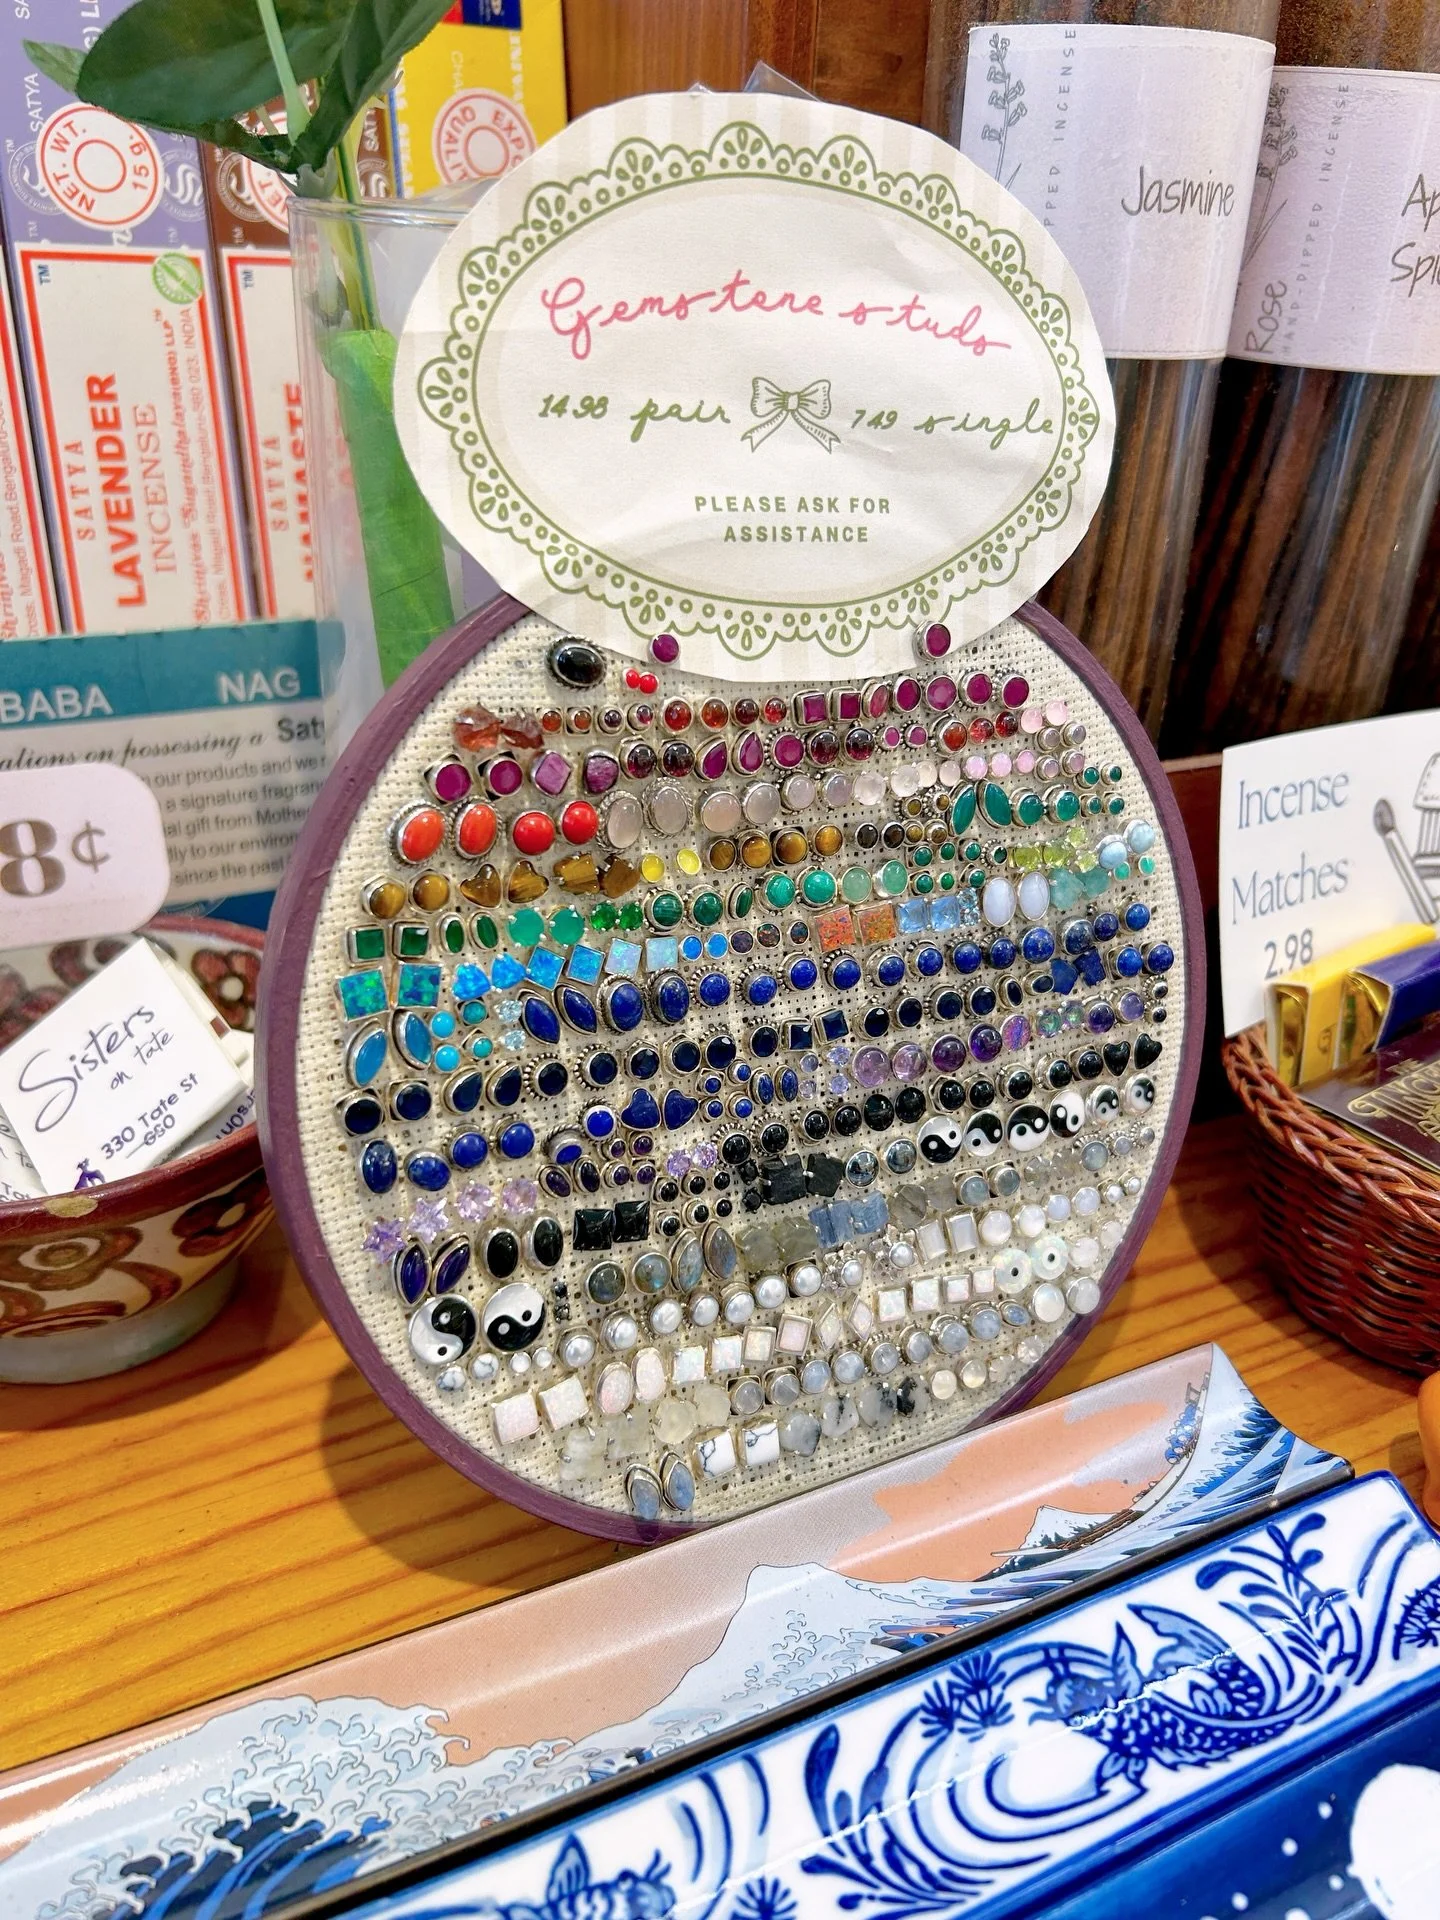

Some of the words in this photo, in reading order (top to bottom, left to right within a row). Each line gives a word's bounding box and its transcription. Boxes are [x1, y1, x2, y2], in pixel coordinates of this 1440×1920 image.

[24, 72, 45, 132] SATYA
[1052, 28, 1078, 143] INCENSE
[1318, 83, 1350, 183] INCENSE
[131, 164, 150, 191] 15
[1120, 164, 1237, 218] Jasmine
[838, 294, 1013, 357] studs
[1243, 279, 1289, 355] Rose
[629, 398, 732, 444] pair
[913, 397, 1054, 450] single
[64, 440, 96, 541] SATYA
[85, 373, 147, 608] LAVENDER
[133, 402, 178, 574] INCENSE
[262, 435, 290, 532] SATYA
[694, 495, 788, 514] PLEASE
[796, 496, 840, 514] ASK
[850, 496, 892, 515] FOR
[723, 525, 870, 544] ASSISTANCE
[0, 683, 114, 724] BABA
[216, 665, 301, 703] NAG
[84, 748, 115, 764] on
[121, 732, 242, 768] possessing
[150, 771, 182, 789] our
[186, 758, 259, 787] products
[262, 755, 293, 775] and
[295, 754, 319, 771] we
[180, 787, 259, 814] signature
[185, 815, 211, 841] gift
[214, 812, 253, 832] from
[1237, 770, 1351, 830] Incense
[173, 868, 218, 888] since
[220, 861, 247, 879] the
[250, 857, 284, 878] past
[209, 840, 236, 856] our
[1230, 850, 1350, 926] Matches
[1263, 927, 1315, 981] 2.98
[18, 1005, 156, 1133] Sisters
[109, 1070, 134, 1090] on
[100, 1125, 136, 1160] 330
[137, 1091, 180, 1128] Tate
[178, 1072, 200, 1094] St
